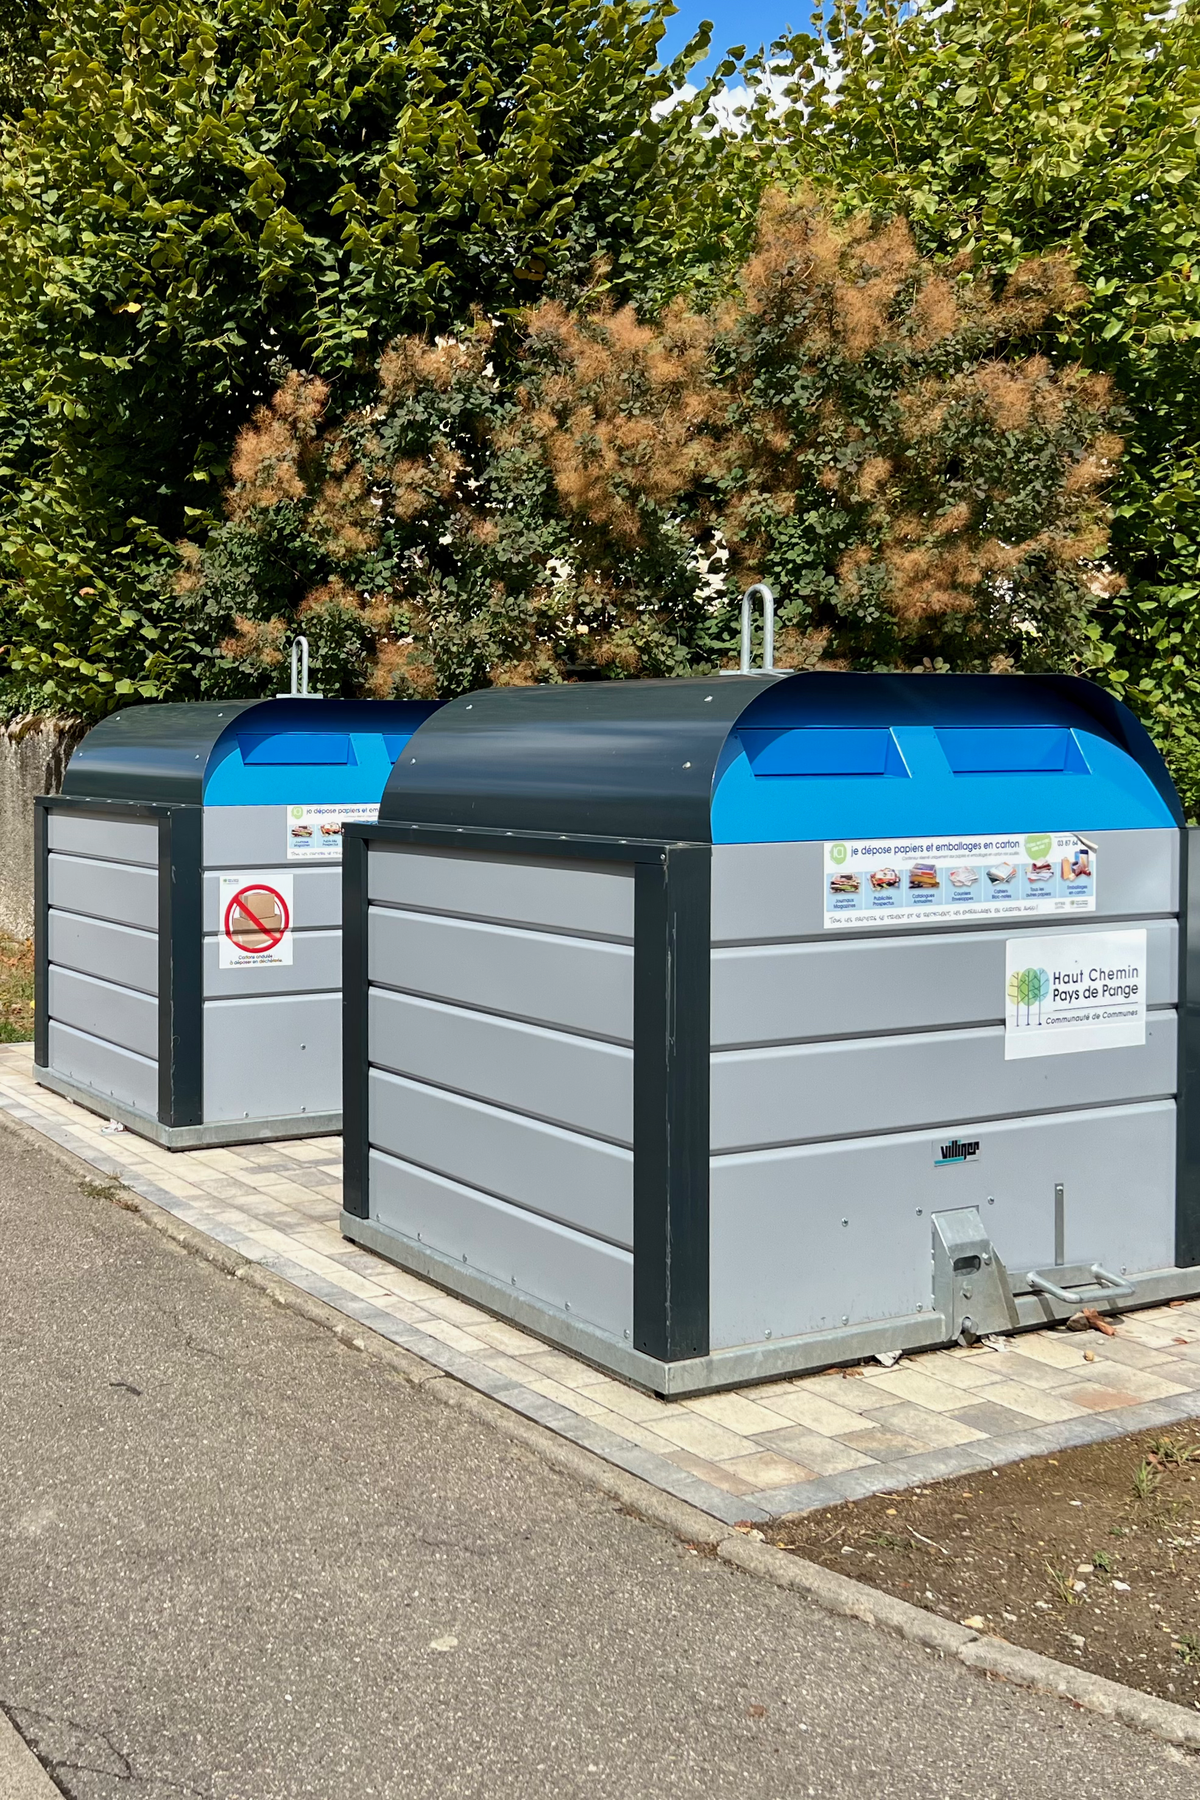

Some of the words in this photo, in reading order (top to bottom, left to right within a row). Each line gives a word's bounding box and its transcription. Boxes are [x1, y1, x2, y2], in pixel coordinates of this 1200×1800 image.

[314, 807, 336, 815] dépose
[850, 846, 859, 858] je
[861, 845, 892, 856] dépose
[894, 843, 924, 856] papiers
[926, 842, 934, 852] et
[936, 841, 982, 852] emballages
[984, 841, 994, 850] en
[995, 839, 1020, 849] carton
[1053, 970, 1084, 985] Haut
[1089, 965, 1138, 982] Chemin
[1053, 988, 1080, 1004] Pays
[1083, 986, 1098, 999] de
[1102, 984, 1138, 998] Pange
[1046, 1013, 1090, 1024] Communauté
[1102, 1010, 1138, 1018] Communes
[940, 1140, 980, 1160] villiger
